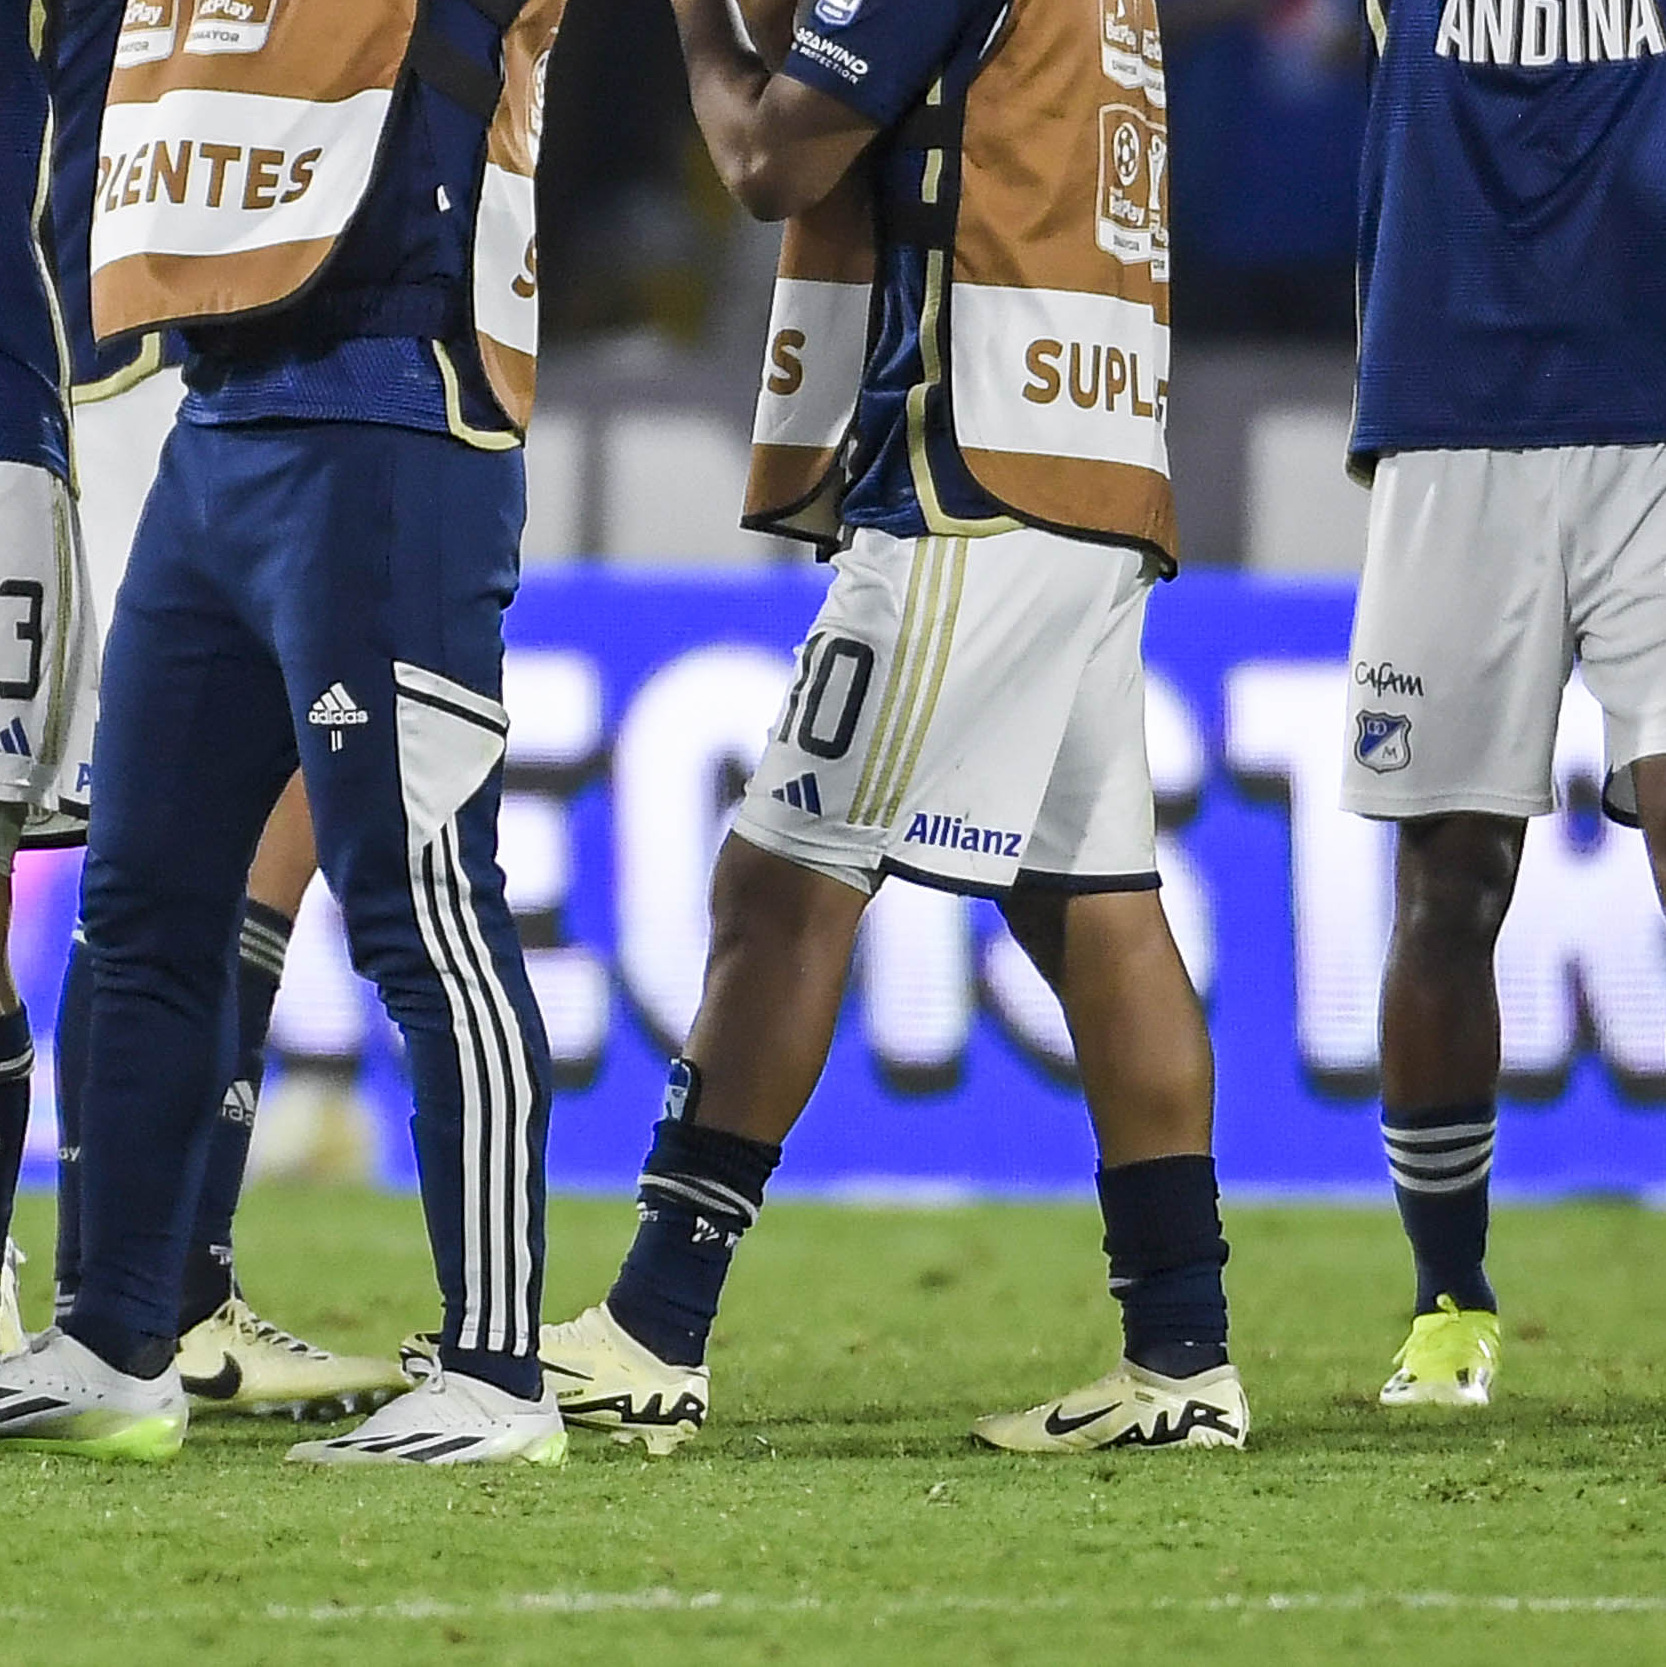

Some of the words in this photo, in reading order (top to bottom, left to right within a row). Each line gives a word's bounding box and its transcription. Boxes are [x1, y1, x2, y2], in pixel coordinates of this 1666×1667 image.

[778, 631, 874, 759] 10
[309, 710, 369, 726] adidas
[904, 812, 1022, 857] Allianz
